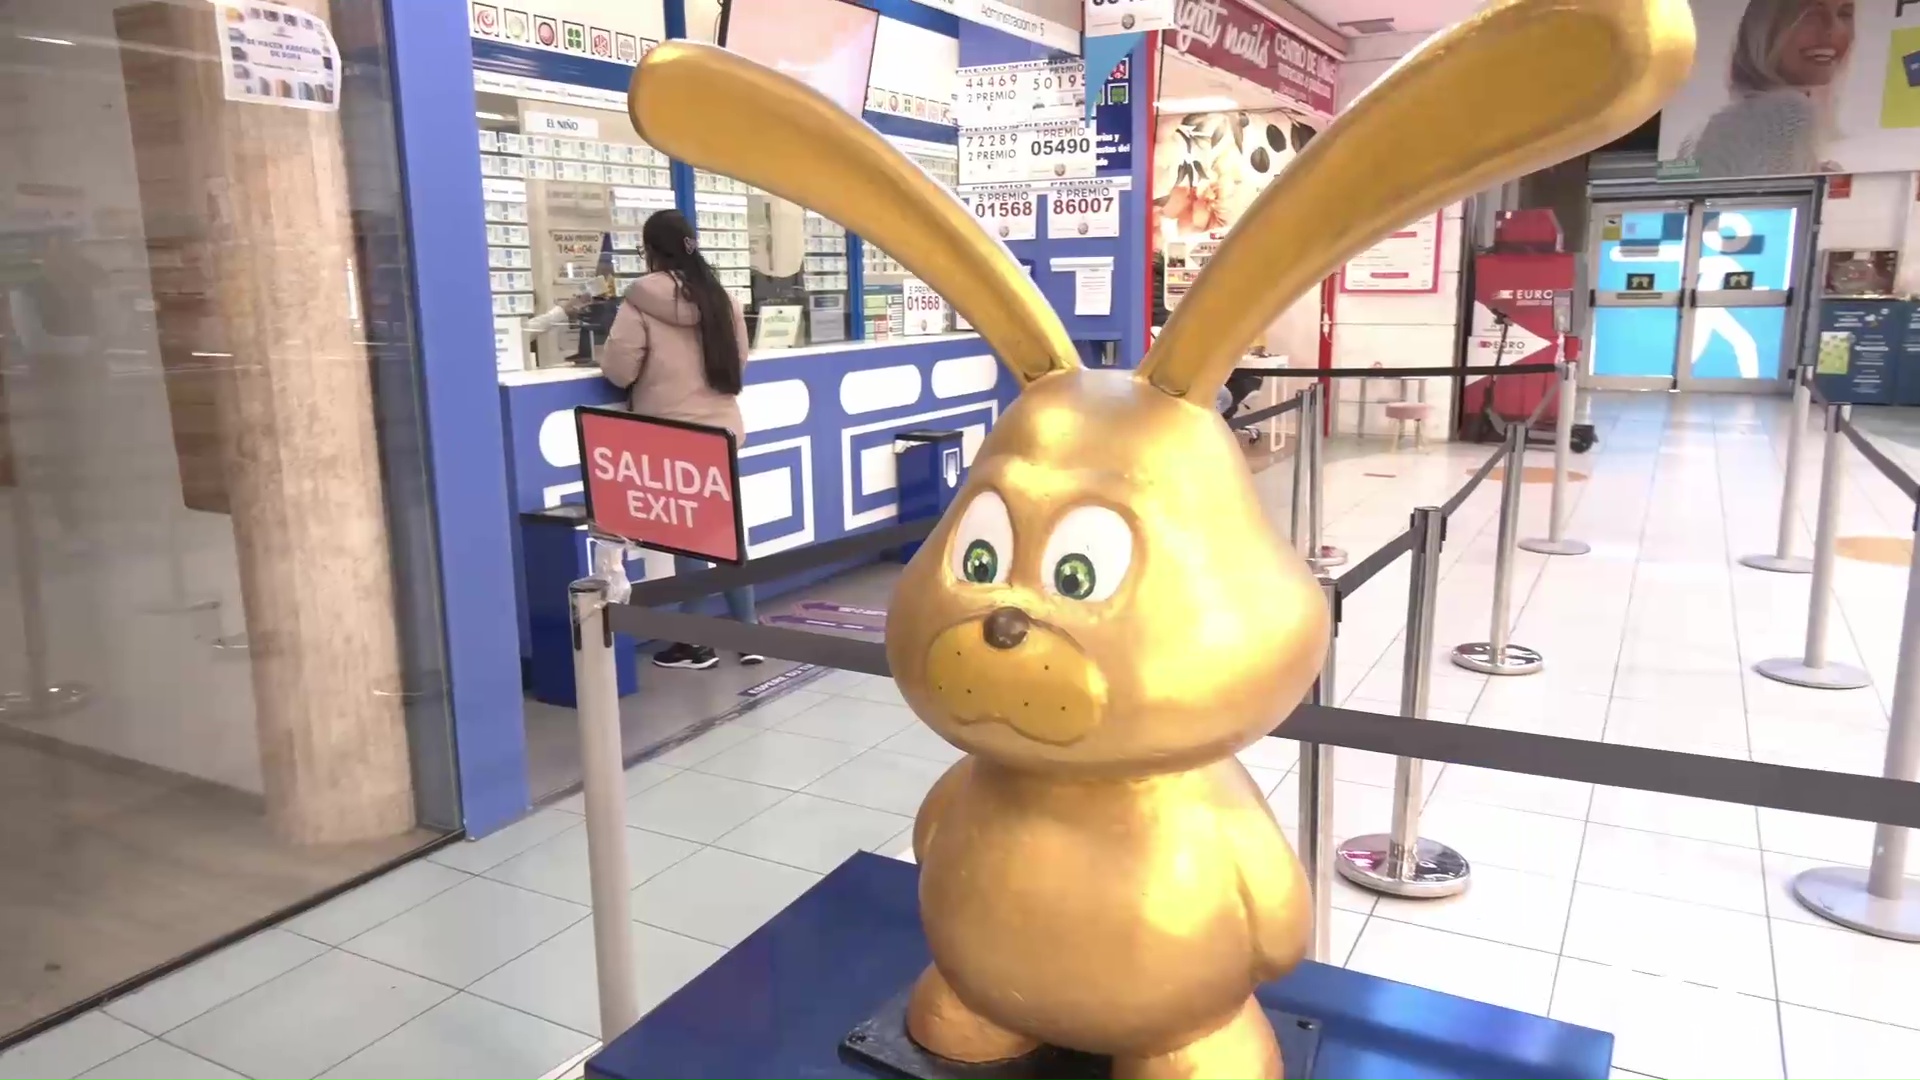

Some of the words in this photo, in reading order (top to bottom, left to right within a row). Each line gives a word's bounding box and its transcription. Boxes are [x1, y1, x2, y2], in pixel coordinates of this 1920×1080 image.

[1175, 0, 1228, 52] ight
[1222, 22, 1270, 69] nails
[965, 73, 1018, 89] 44469
[976, 89, 1016, 102] PREMIO
[546, 118, 555, 128] EL
[556, 118, 579, 131] NIÑO
[1043, 127, 1085, 138] PREMIO
[965, 132, 1018, 148] 72289
[1030, 137, 1091, 156] 05490
[967, 151, 974, 161] 2
[976, 148, 1017, 160] PREMIO
[971, 183, 1032, 191] PREMIOS
[1050, 178, 1113, 187] PREMIOS
[987, 191, 1029, 202] PREMIO
[1066, 187, 1110, 198] PREMIO
[974, 201, 1033, 218] 01568
[1052, 196, 1115, 215] 86007
[1515, 289, 1553, 300] EURO
[906, 295, 940, 311] 01568
[593, 446, 730, 502] SALIDA
[626, 490, 699, 529] EXIT
